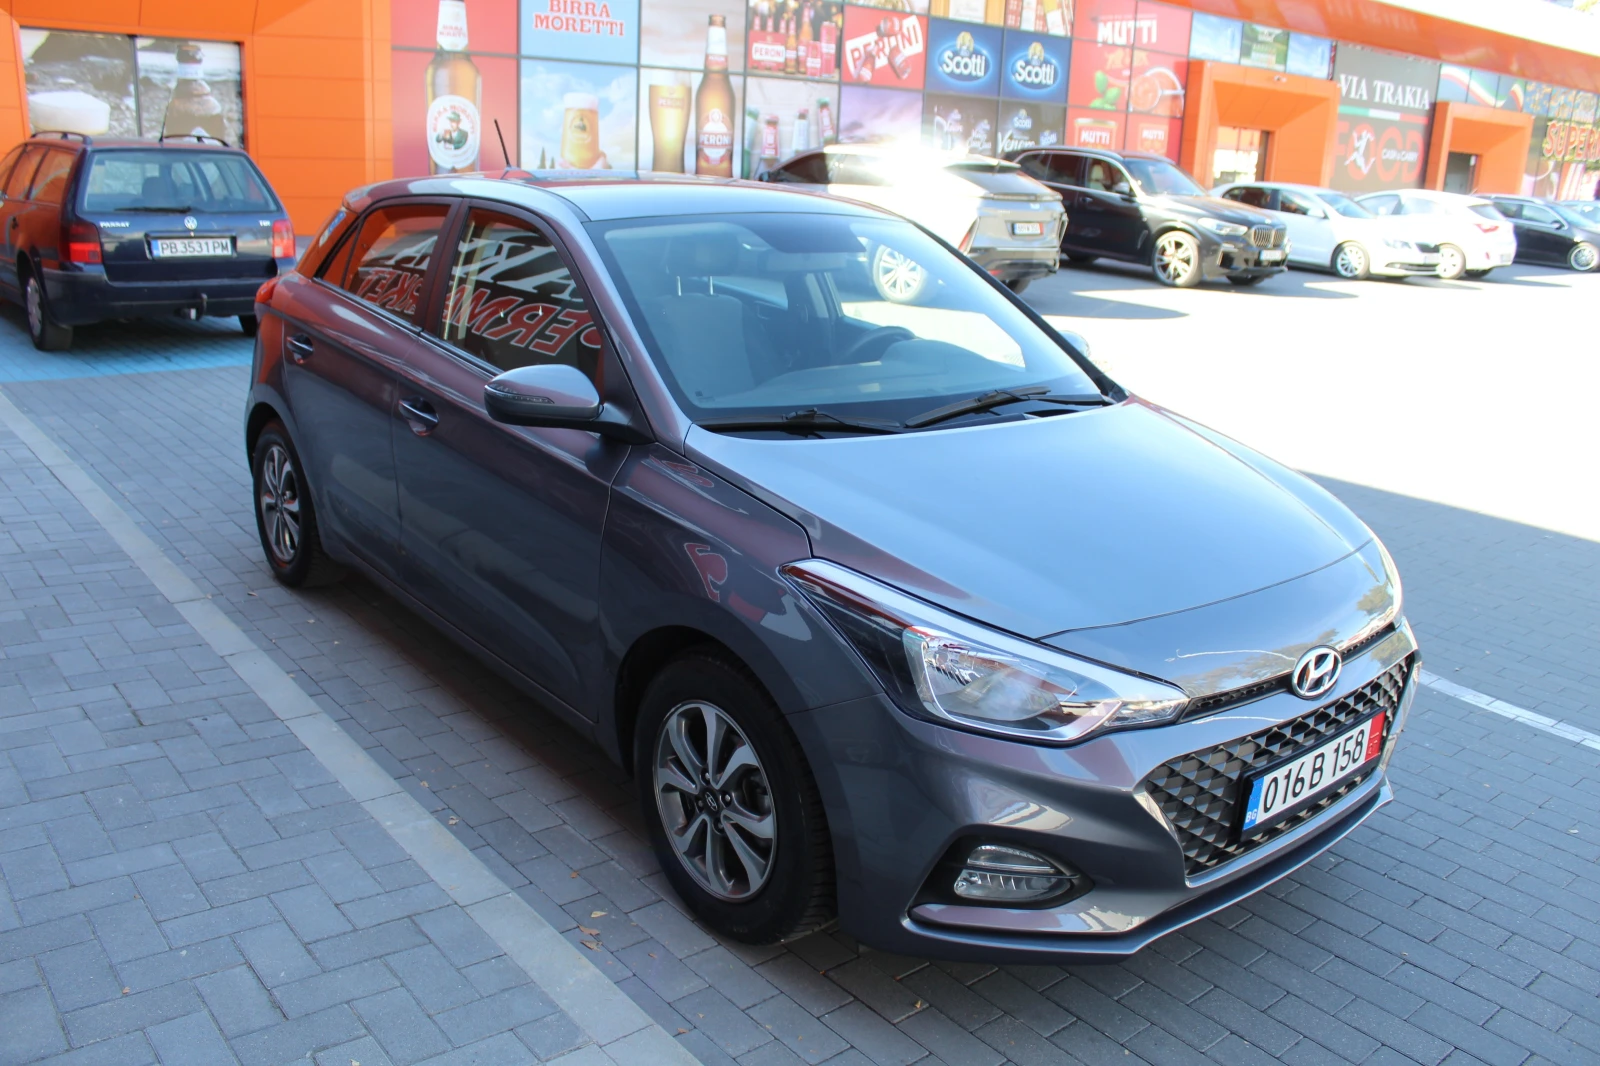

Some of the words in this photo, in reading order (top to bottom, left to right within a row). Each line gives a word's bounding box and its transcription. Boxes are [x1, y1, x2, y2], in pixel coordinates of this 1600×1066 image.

[549, 0, 611, 18] BIRRA
[534, 13, 625, 37] MORETTI
[1096, 19, 1158, 48] MUTTI
[754, 45, 784, 58] PERONI
[942, 49, 986, 78] Scotti
[1014, 59, 1055, 86] Scotti
[1339, 73, 1369, 102] VIA
[1372, 79, 1430, 111] TRAKIA
[160, 243, 178, 254] PB
[180, 241, 210, 254] 3531
[212, 241, 229, 253] PM
[1263, 761, 1307, 814] 016
[1332, 728, 1366, 778] 158
[1246, 809, 1258, 823] BG
